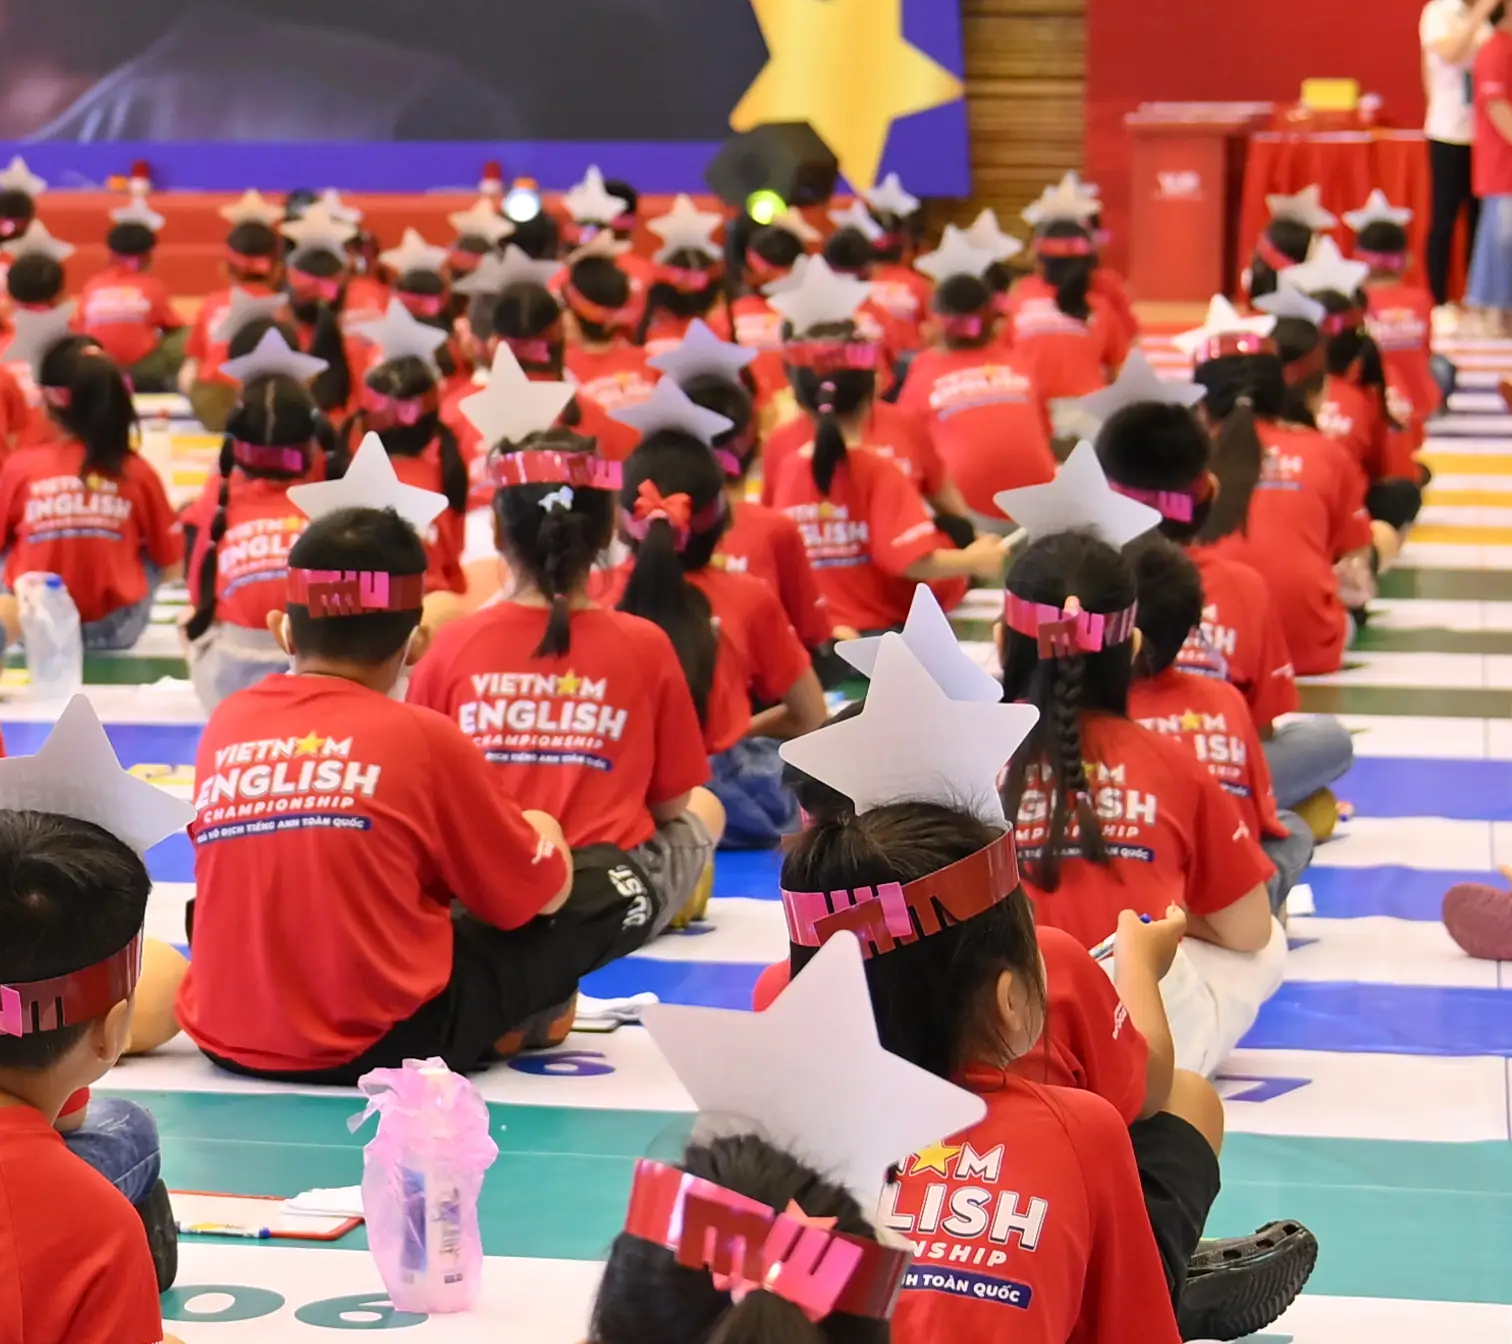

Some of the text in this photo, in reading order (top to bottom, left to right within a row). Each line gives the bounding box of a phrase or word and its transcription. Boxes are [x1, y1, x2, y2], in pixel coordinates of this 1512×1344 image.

[460, 697, 629, 740] ENGLISH
[197, 760, 381, 810] ENGLISH
[204, 795, 354, 823] CHAMPIONSHIP
[278, 818, 299, 829] ANH
[302, 813, 330, 827] TOÀN
[888, 1181, 1048, 1252] LISH
[921, 1270, 1020, 1304] TOÀN QUỐC
